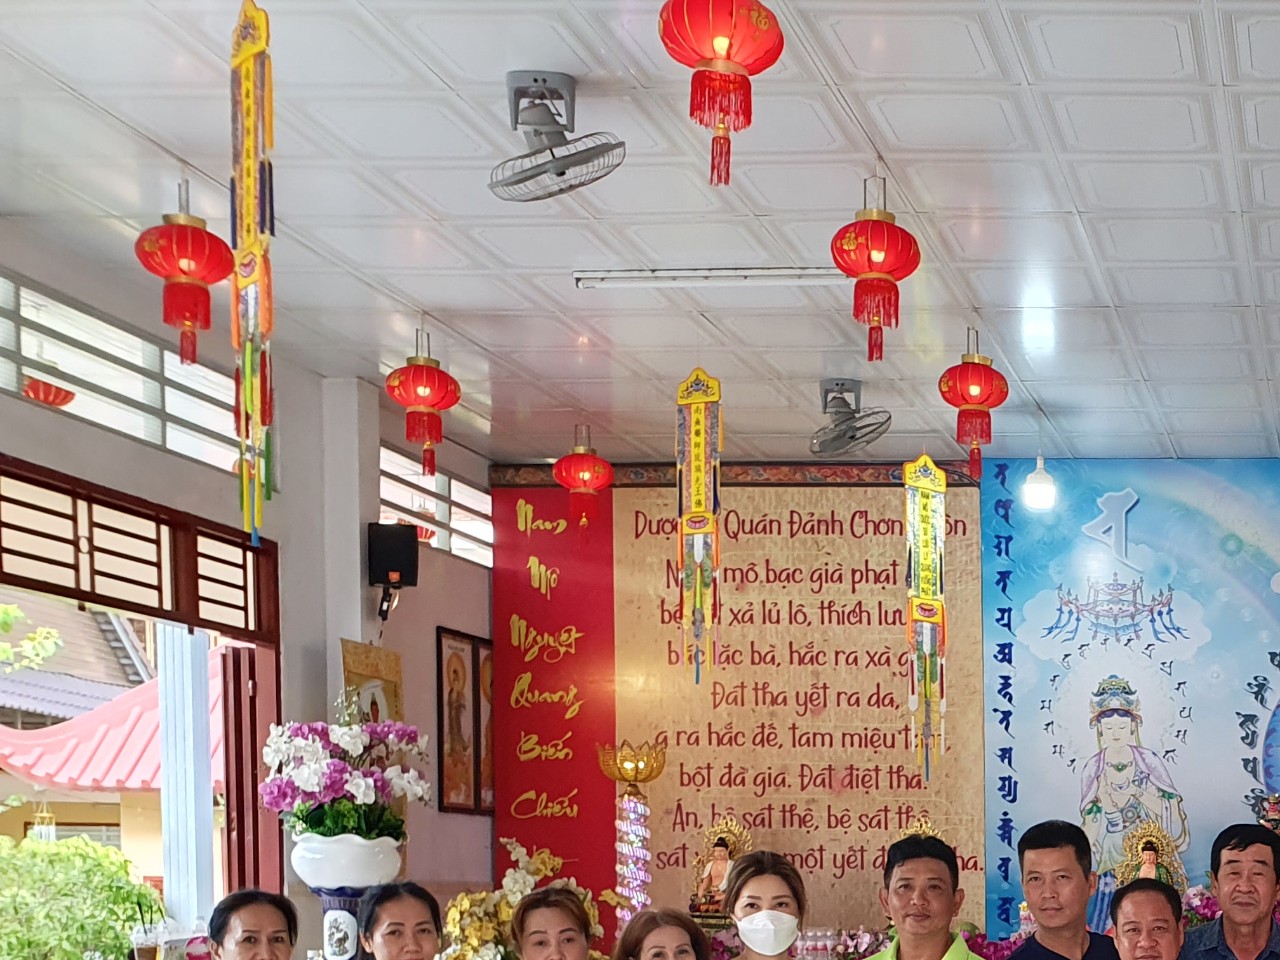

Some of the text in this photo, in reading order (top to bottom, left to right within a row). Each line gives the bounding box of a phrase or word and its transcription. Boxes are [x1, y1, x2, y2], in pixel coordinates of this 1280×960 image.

[516, 498, 567, 538] Nam
[634, 509, 679, 541] Dượ
[723, 509, 782, 543] Quán
[788, 509, 844, 539] Đảnh
[849, 509, 904, 539] Chơn
[765, 558, 804, 589] bạc
[850, 559, 899, 594] phạt
[728, 601, 754, 627] xả
[788, 601, 812, 627] lô,
[818, 600, 872, 626] thích
[750, 640, 781, 668] bà,
[788, 640, 827, 666] hắc
[834, 650, 859, 667] ra
[865, 646, 891, 669] xà
[510, 671, 584, 720] Quang
[752, 681, 788, 707] tha
[836, 691, 861, 708] ra
[866, 682, 900, 711] da,
[516, 730, 573, 761] Biến
[676, 730, 700, 747] ra
[707, 721, 746, 747] hắc
[751, 721, 783, 750] đế,
[788, 722, 834, 749] tam
[841, 727, 896, 755] miệu
[679, 762, 714, 793] bột
[752, 766, 792, 798] gia.
[840, 763, 882, 795] điệt
[888, 764, 928, 790] tha.
[510, 787, 578, 818] Chiếu
[671, 798, 704, 833] Án,
[779, 803, 819, 835] thệ,
[827, 804, 852, 835] bệ
